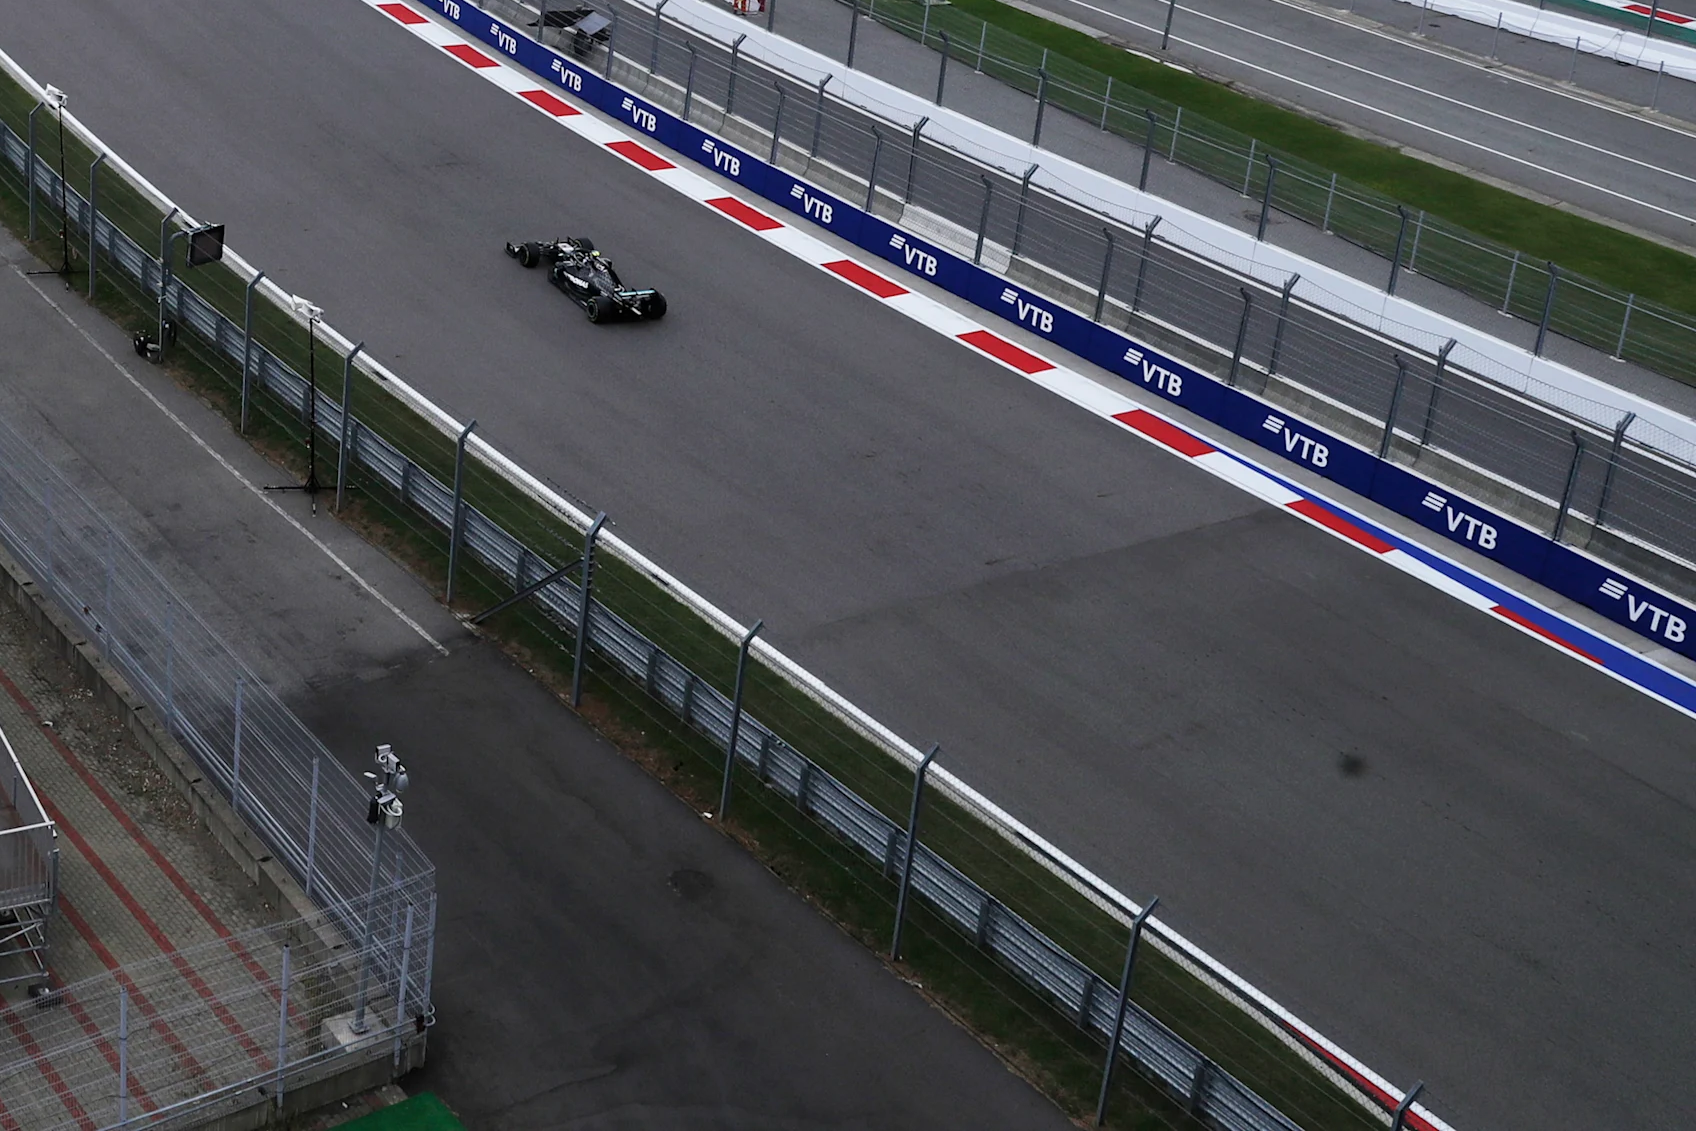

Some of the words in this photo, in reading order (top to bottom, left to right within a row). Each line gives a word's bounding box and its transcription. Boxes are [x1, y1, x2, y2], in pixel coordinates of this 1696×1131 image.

[498, 31, 517, 55] VTB
[560, 69, 582, 92] VTB
[632, 105, 657, 132] VTB
[713, 148, 741, 176] VTB
[804, 194, 832, 224] VTB
[905, 244, 937, 276] VTB
[1018, 298, 1053, 333] VTB
[1143, 360, 1182, 397] VTB
[1284, 428, 1329, 467] VTB
[1447, 506, 1497, 549] VTB
[1628, 594, 1687, 643] VTB
